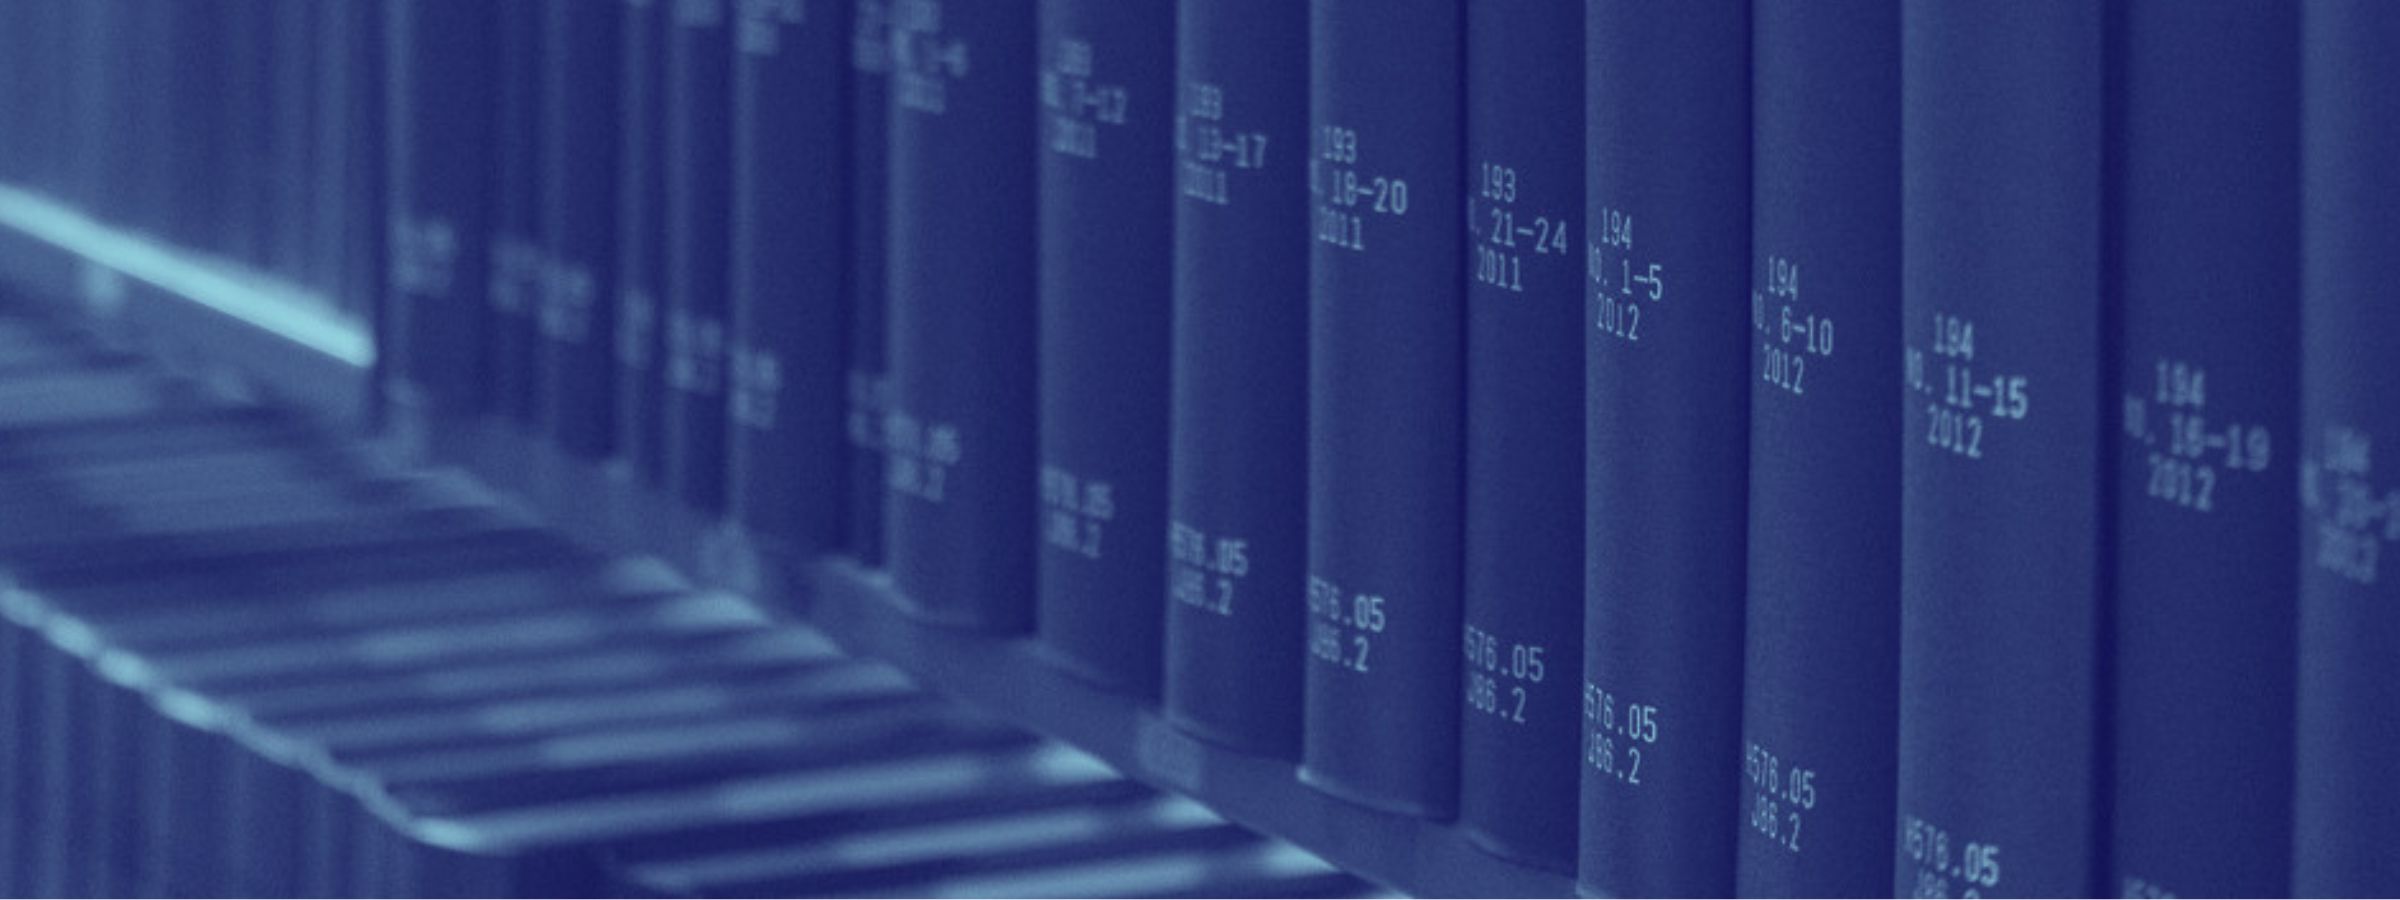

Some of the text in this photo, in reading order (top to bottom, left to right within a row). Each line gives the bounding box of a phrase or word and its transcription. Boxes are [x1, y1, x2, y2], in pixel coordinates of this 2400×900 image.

[1321, 125, 1357, 165] 193
[1331, 169, 1409, 216] 18-20
[1481, 161, 1517, 204] 193
[1490, 206, 1568, 256] 21-24
[1601, 206, 1634, 251] 194
[1476, 244, 1524, 292] 2011
[1621, 258, 1664, 302] 1-5
[1768, 254, 1799, 302] 194
[1596, 292, 1641, 342] 2012
[1782, 306, 1835, 357] 6-10
[1934, 312, 1974, 362] 194
[1763, 343, 1805, 395] 2012
[1945, 364, 2029, 421] 11-15
[1927, 402, 1983, 460] 2012
[2148, 450, 2217, 512] 2012
